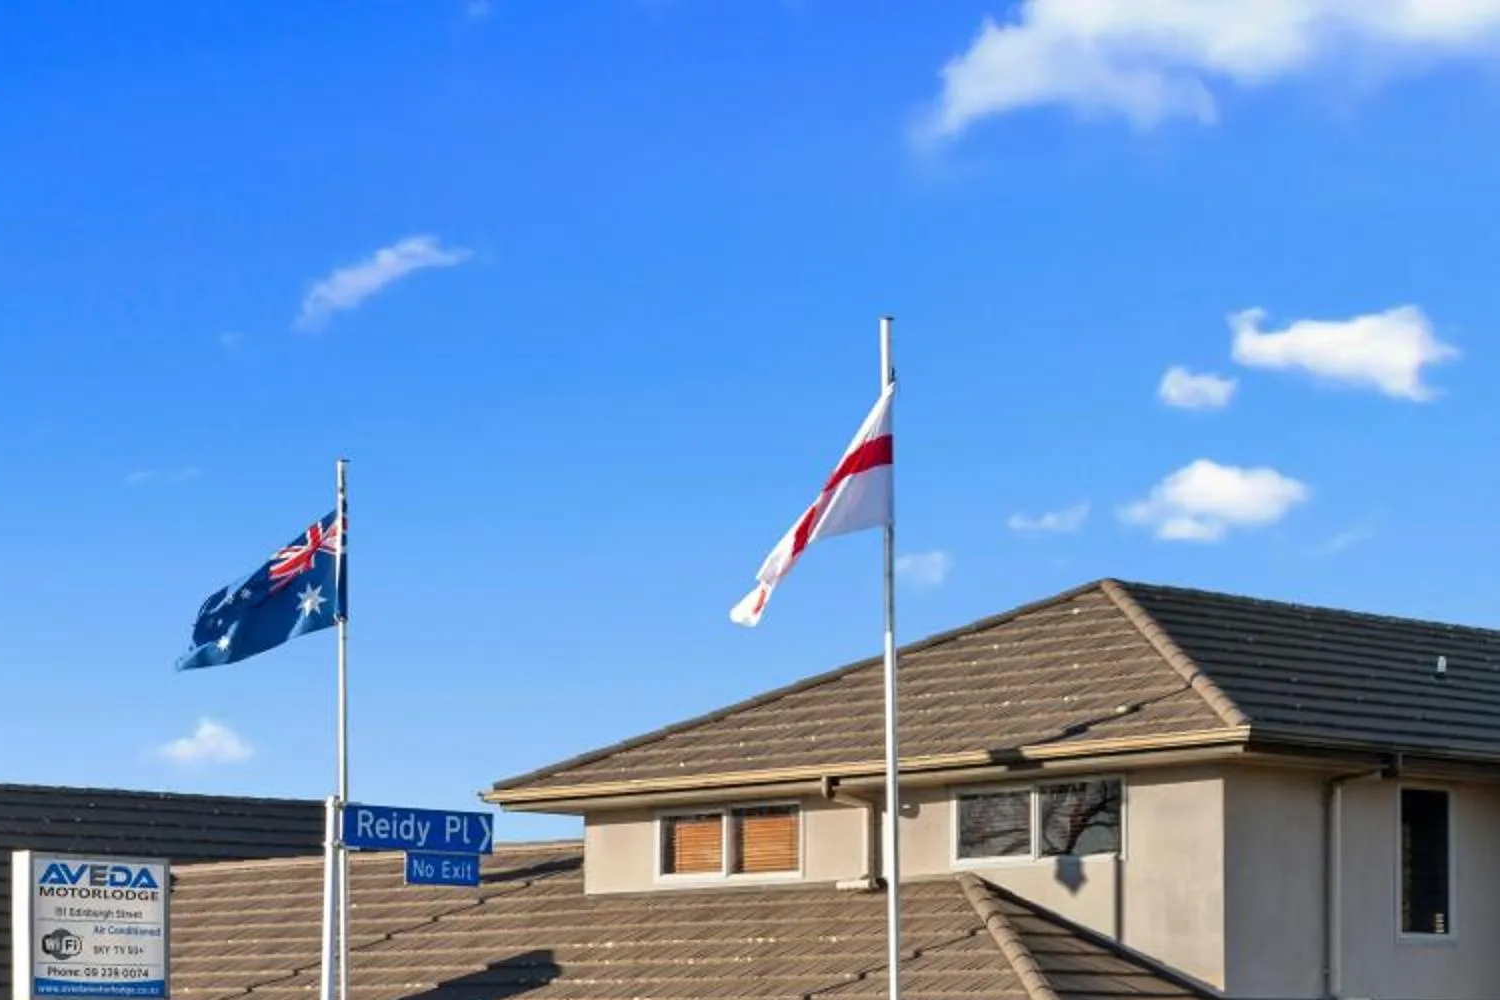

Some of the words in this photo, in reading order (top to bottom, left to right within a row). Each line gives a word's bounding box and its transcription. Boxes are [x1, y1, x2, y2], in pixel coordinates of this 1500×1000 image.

[357, 809, 431, 847] Reidy
[445, 815, 471, 844] Pl
[39, 863, 158, 889] AVEDA
[412, 859, 435, 878] No
[441, 861, 474, 881] Exit
[39, 887, 159, 901] MOTORLODGE
[116, 909, 142, 919] Street
[114, 946, 125, 954] TV
[85, 967, 99, 977] 09
[121, 968, 150, 979] 0074
